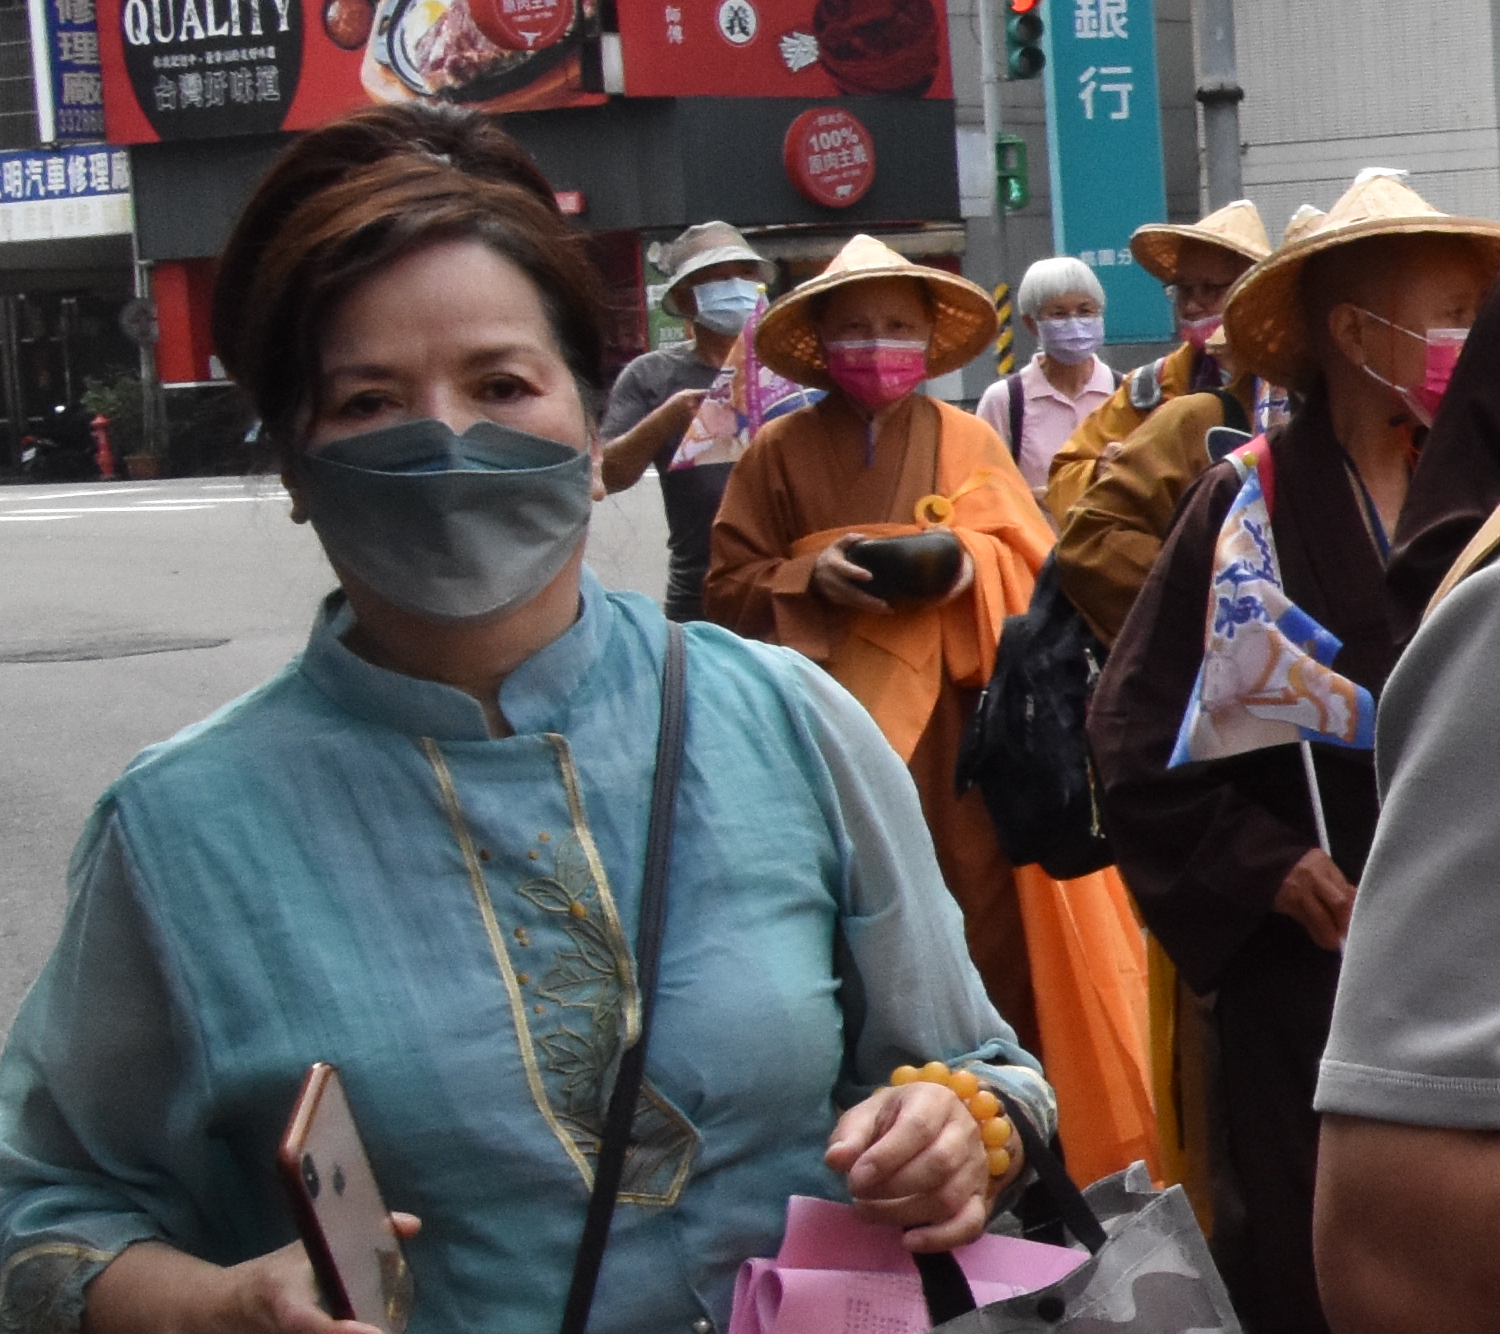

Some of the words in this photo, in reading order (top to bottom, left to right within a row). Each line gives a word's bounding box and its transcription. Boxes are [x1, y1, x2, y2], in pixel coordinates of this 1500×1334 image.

[809, 127, 859, 153] 100%
[0, 150, 130, 199] 明汽車修理廠
